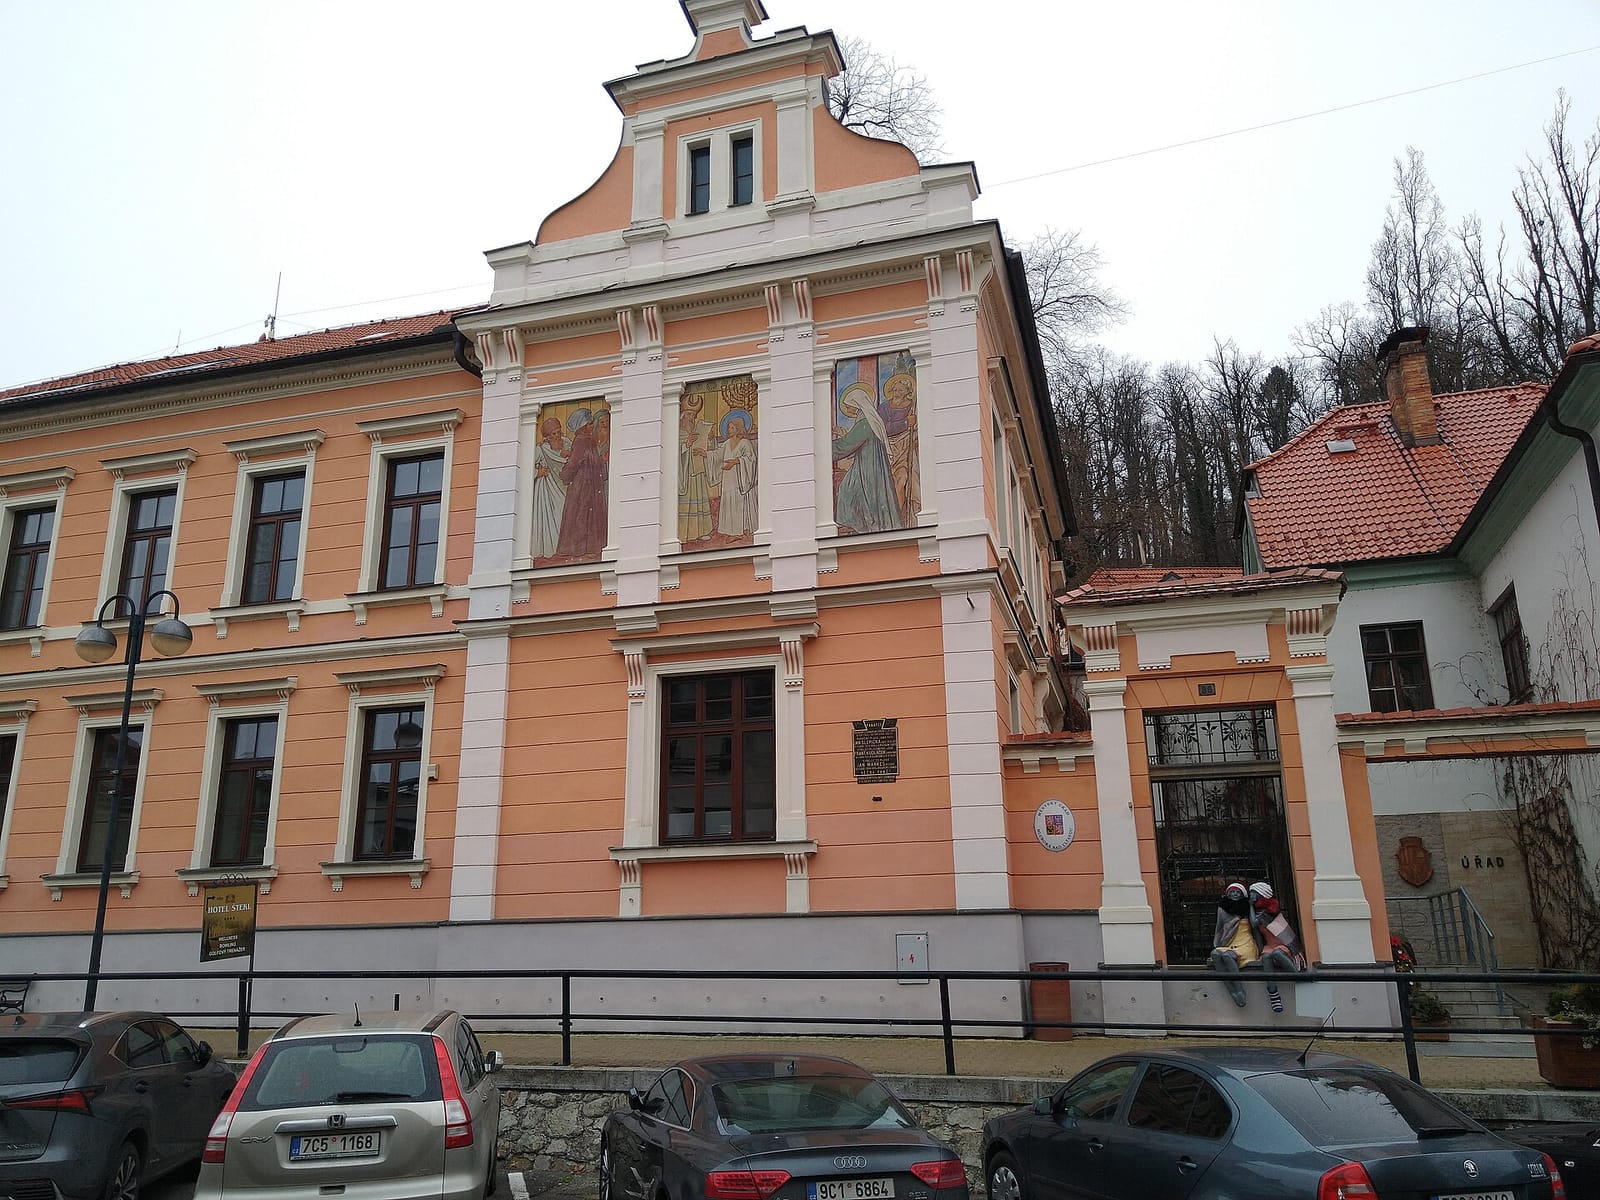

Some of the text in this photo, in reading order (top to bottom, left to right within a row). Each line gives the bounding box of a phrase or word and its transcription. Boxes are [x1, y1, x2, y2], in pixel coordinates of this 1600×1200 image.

[1461, 855, 1504, 869] ÚŘAD
[208, 903, 251, 914] HOTEL ŠTEKL
[303, 1137, 329, 1154] 7C5
[340, 1135, 373, 1151] 1168
[820, 1183, 845, 1199] 9C1
[855, 1180, 889, 1196] 6864
